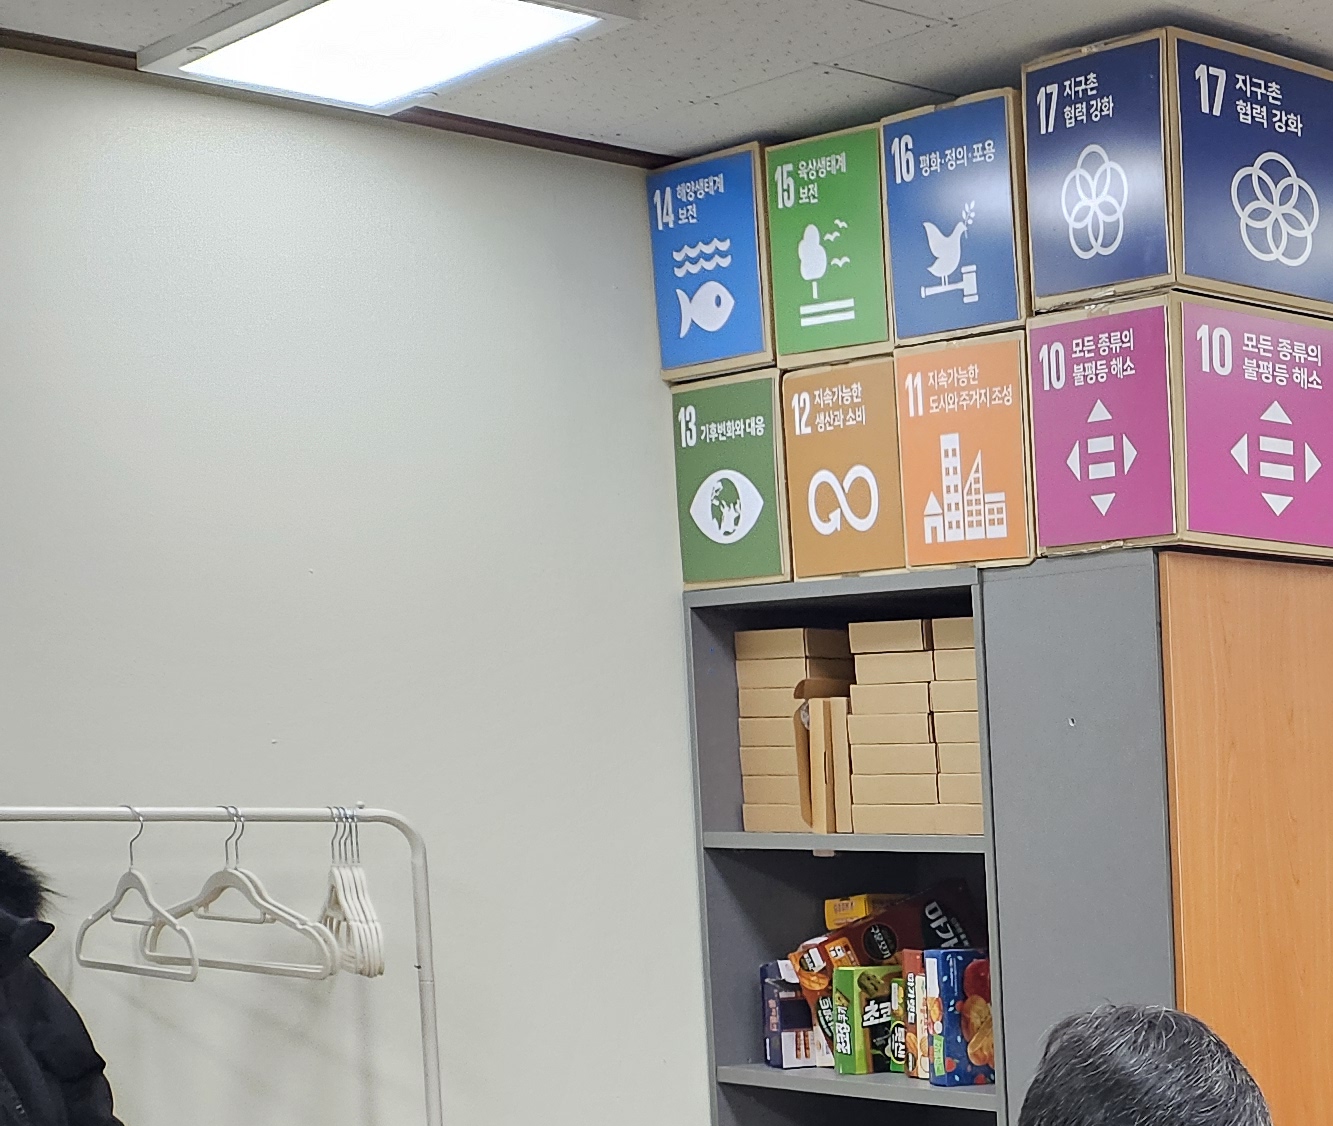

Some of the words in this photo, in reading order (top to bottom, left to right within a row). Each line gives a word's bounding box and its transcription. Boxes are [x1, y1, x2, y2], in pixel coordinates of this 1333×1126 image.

[1063, 72, 1098, 99] 지구촌
[1195, 64, 1227, 117] 17
[1235, 74, 1283, 107] 지구촌
[1036, 83, 1058, 135] 17
[1064, 102, 1087, 129] 협력
[1090, 96, 1114, 122] 강화
[1236, 100, 1268, 128] 협력
[1272, 106, 1304, 137] 강화
[797, 151, 846, 182] 육상생태계
[891, 135, 914, 184] 16
[676, 173, 725, 203] 해양생태계
[774, 163, 794, 210] 15
[799, 185, 818, 205] 보전
[654, 187, 674, 230] 14
[678, 205, 697, 225] 보전
[1071, 334, 1095, 358] 모든
[1098, 327, 1134, 356] 종류의
[1197, 324, 1233, 376] 10
[1242, 332, 1273, 358] 모든
[1277, 337, 1322, 367] 종류의
[928, 363, 979, 390] 지속가능한
[1039, 341, 1066, 391] 10
[1073, 359, 1107, 386] 불평등
[1110, 355, 1136, 380] 해소
[1242, 356, 1290, 386] 불평등
[1293, 365, 1323, 391] 해소
[813, 382, 862, 408] 지속가능한
[905, 371, 923, 417] 11
[929, 390, 959, 414] 도시와
[959, 386, 990, 411] 주거지
[991, 382, 1013, 407] 조성
[678, 404, 697, 448] 13
[700, 421, 744, 444] 기후변화와
[745, 415, 766, 437] 대응
[791, 391, 811, 435] 12
[815, 408, 844, 432] 생산과
[846, 405, 866, 427] 소비
[862, 1000, 891, 1027] 초코
